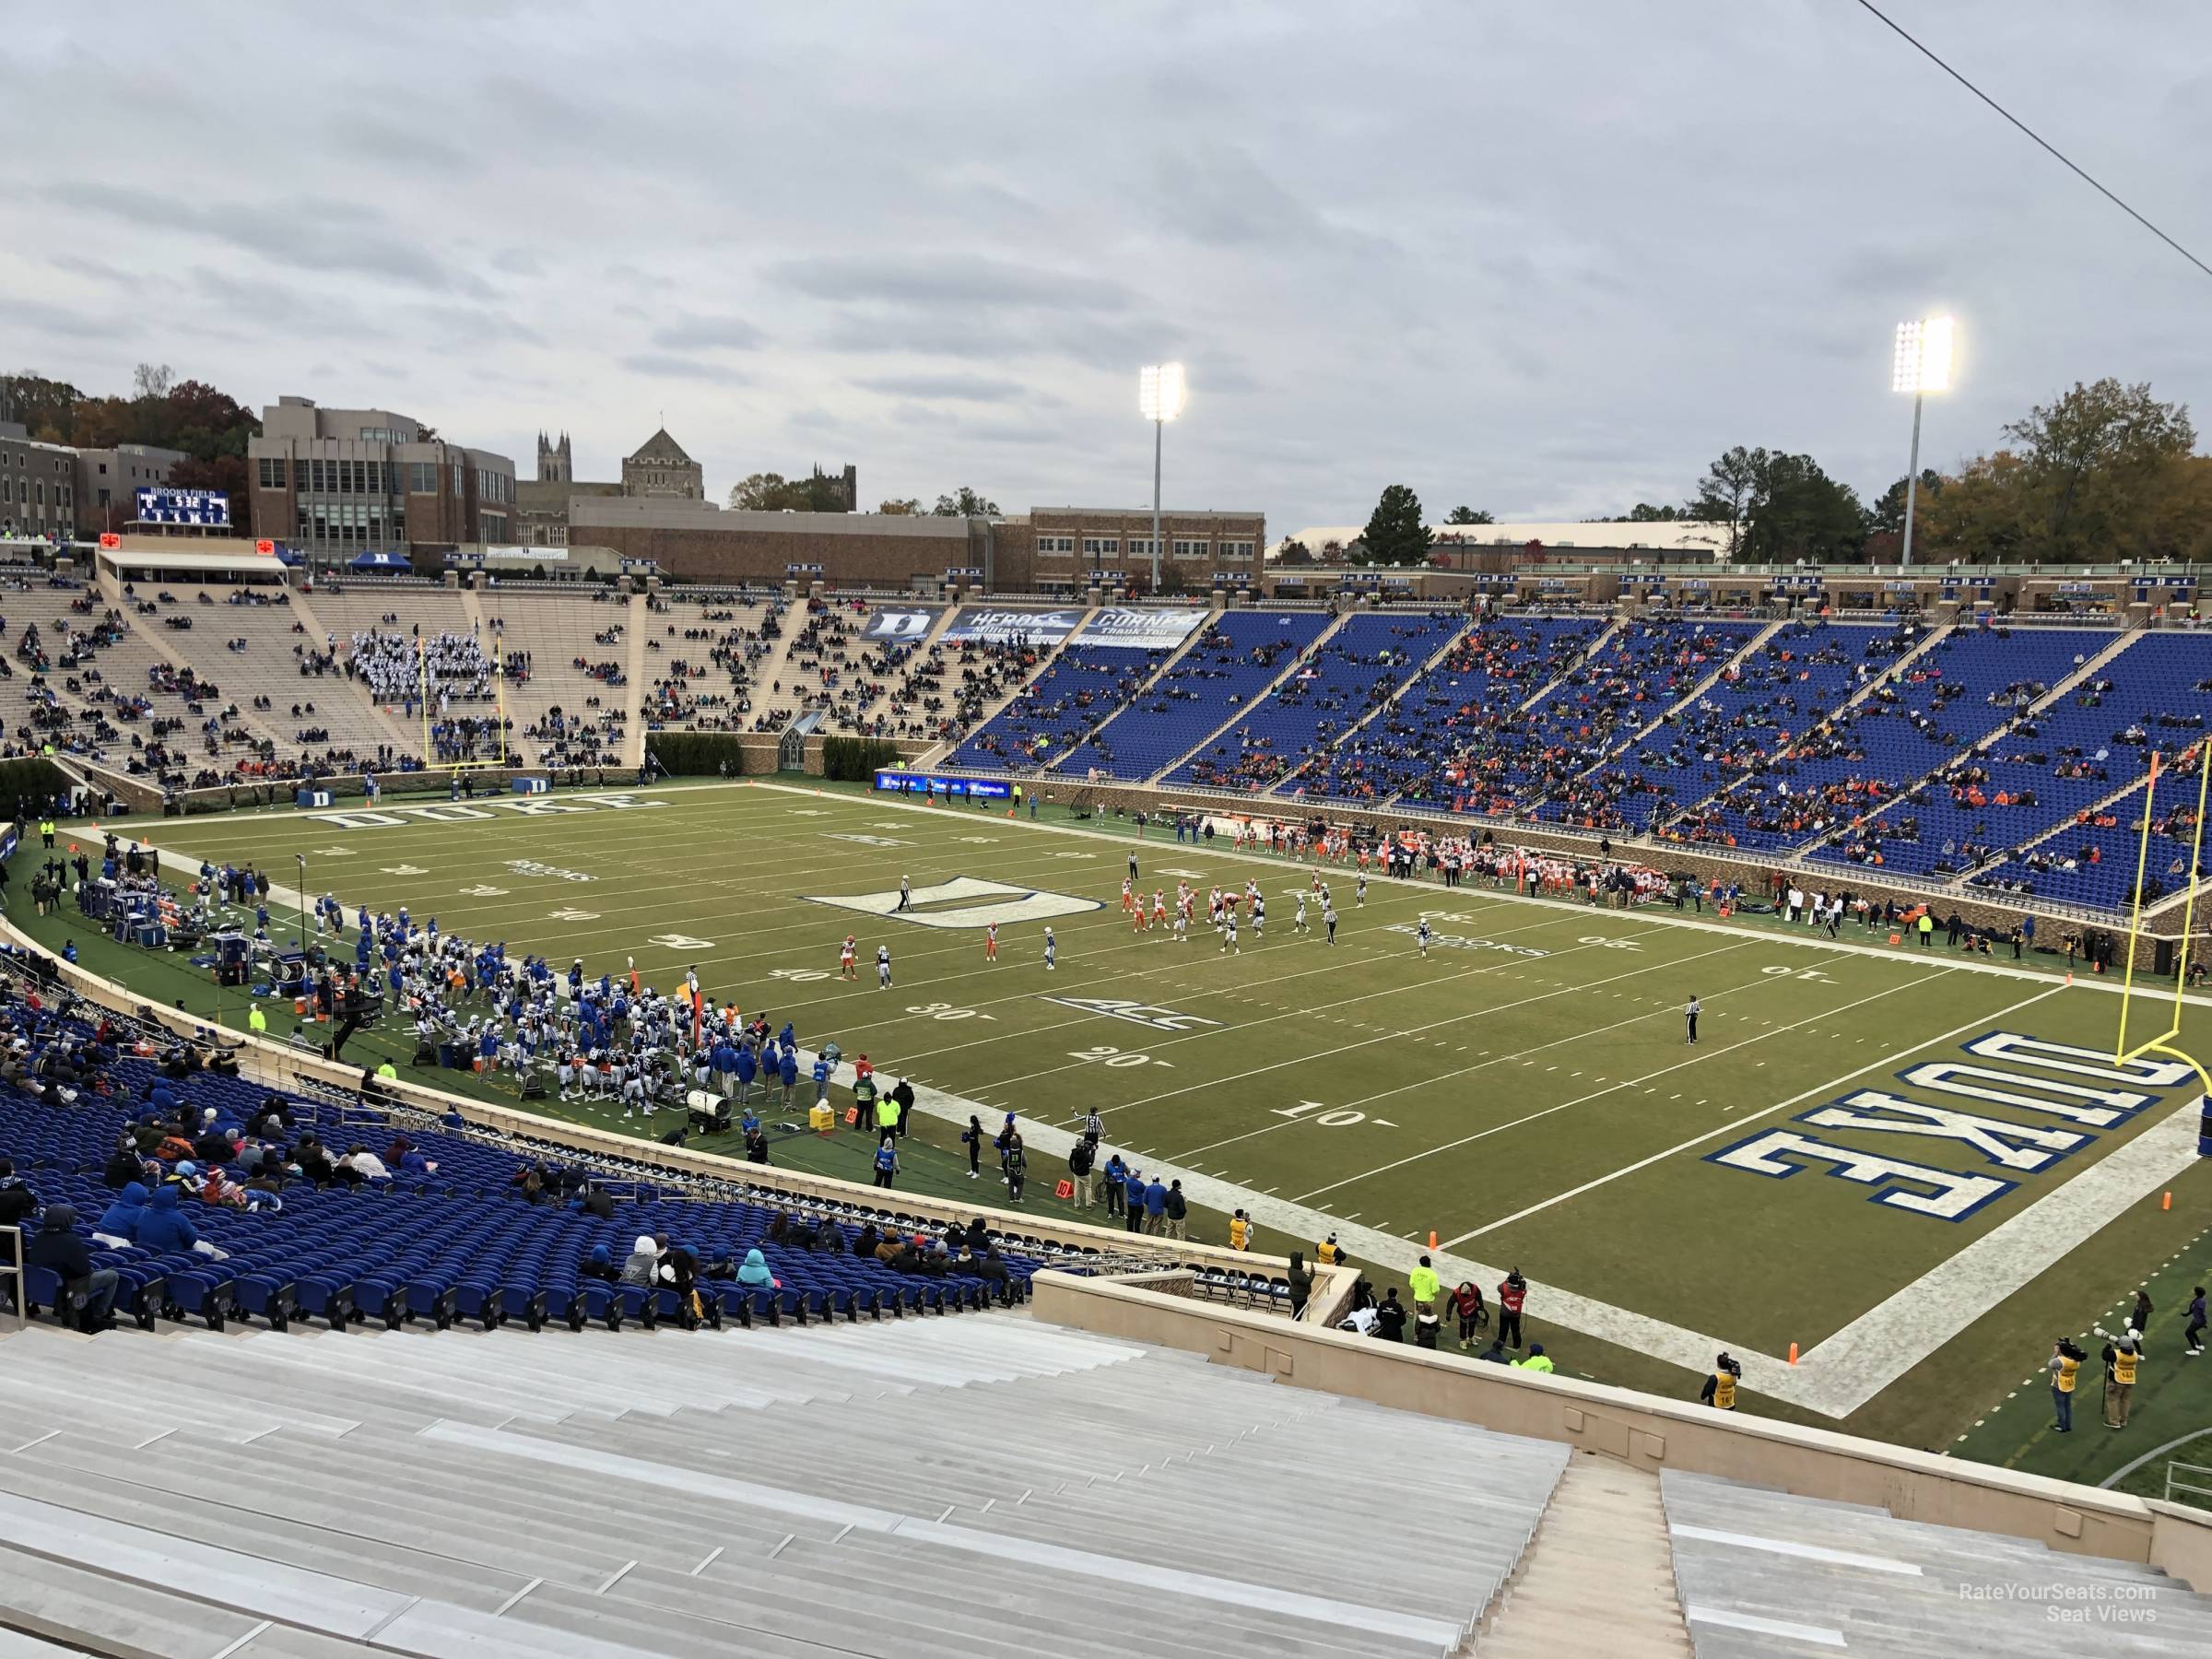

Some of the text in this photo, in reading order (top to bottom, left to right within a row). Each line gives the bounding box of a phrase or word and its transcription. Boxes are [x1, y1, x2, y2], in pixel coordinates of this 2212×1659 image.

[150, 487, 188, 498] BROOKS
[190, 488, 216, 499] FIELD
[971, 612, 1063, 628] HEROES
[972, 626, 1027, 634] Military
[307, 794, 672, 829] DUKE
[767, 968, 831, 982] 40
[905, 1002, 977, 1020] 30
[1032, 995, 1231, 1030] ACC
[1066, 1045, 1150, 1067] 20
[846, 1110, 856, 1121] 20
[1270, 1100, 1367, 1127] 10
[1701, 1030, 2208, 1222] DUKE
[1059, 1182, 1068, 1195] 10
